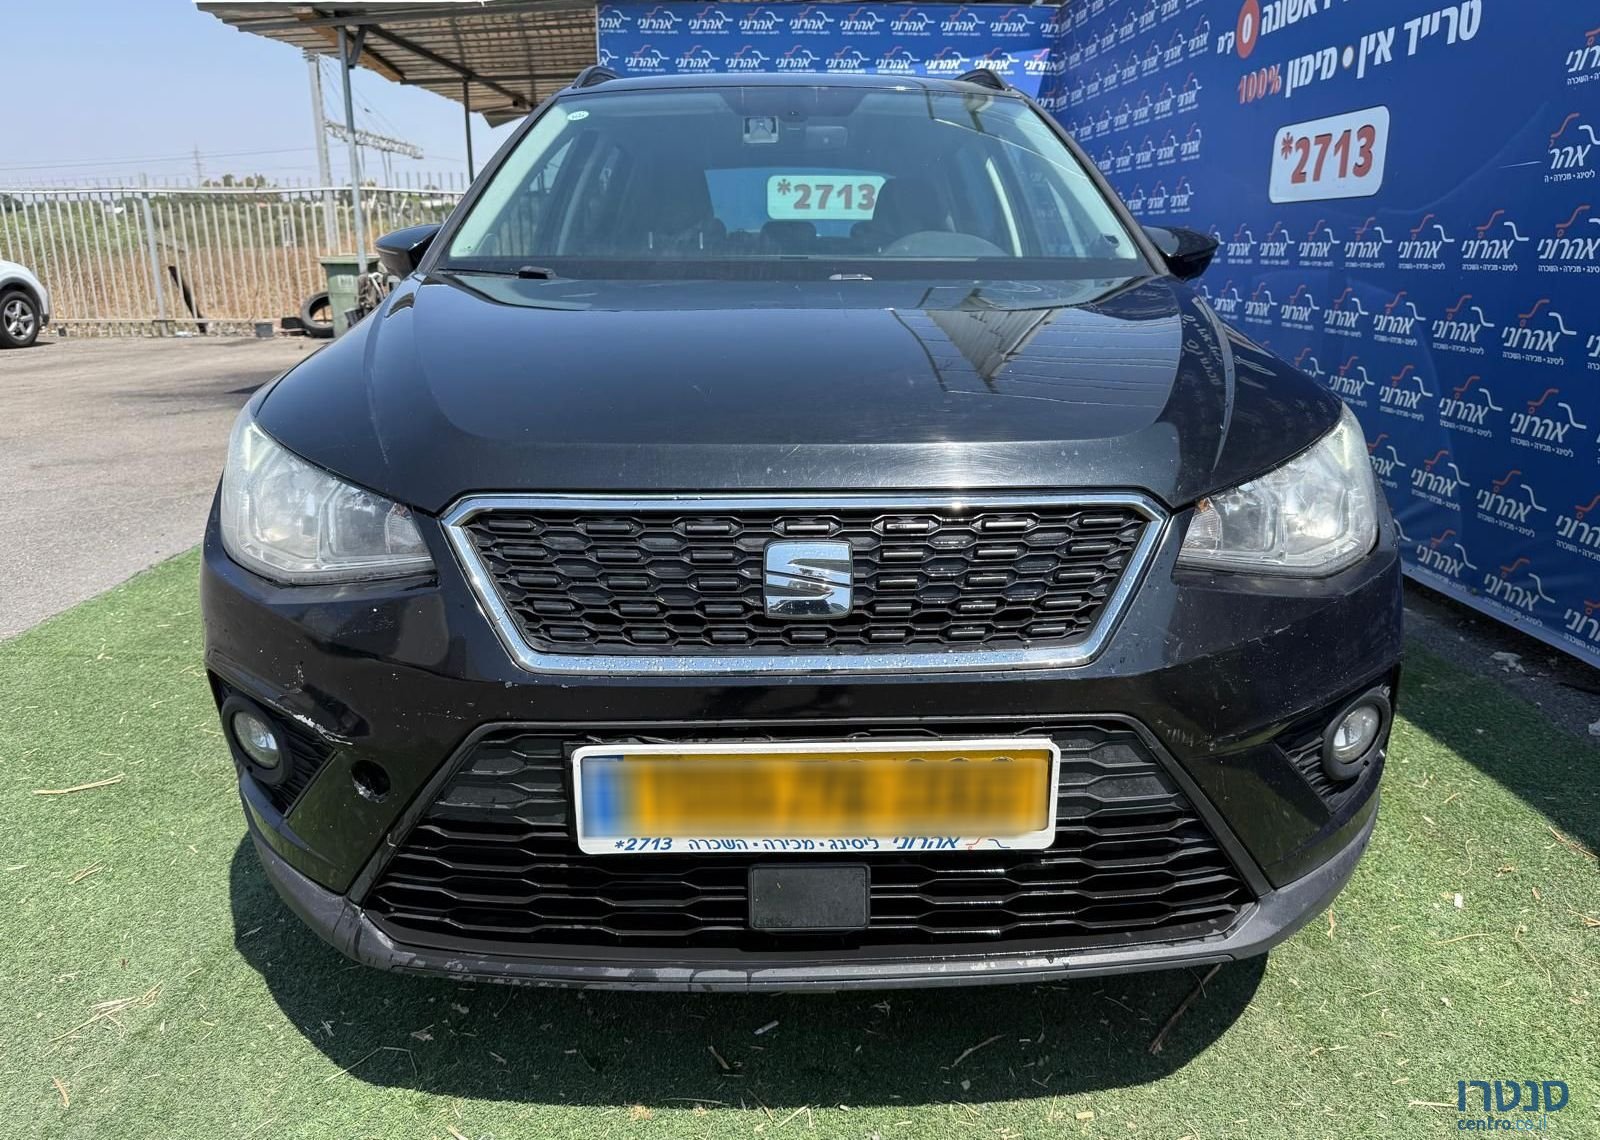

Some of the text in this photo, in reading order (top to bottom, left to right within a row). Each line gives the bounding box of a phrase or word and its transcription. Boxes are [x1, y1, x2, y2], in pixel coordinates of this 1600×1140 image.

[1238, 0, 1482, 104] טרייד אין מימון 100%
[1344, 241, 1382, 258] אהרוני
[1398, 241, 1442, 259] אהרוני
[1461, 239, 1514, 259] אהרוני
[1537, 237, 1600, 260] אהרוני
[1324, 309, 1359, 328] אהרוני
[1373, 315, 1415, 335] אהרוני
[1432, 320, 1481, 343] אהרוני
[1501, 327, 1561, 352] אהרוני
[1379, 386, 1421, 409] אהרוני
[1439, 397, 1489, 425] אהרוני
[1510, 412, 1570, 443] אהרוני
[1411, 468, 1457, 497] אהרוני
[1476, 489, 1532, 523] אהרוני
[1416, 545, 1465, 578] אהרוני
[1484, 573, 1539, 612] אהרוני
[688, 838, 749, 851] השכרה
[763, 838, 815, 850] מכירה
[828, 836, 879, 850] ליסינג
[893, 837, 960, 849] אהרוני
